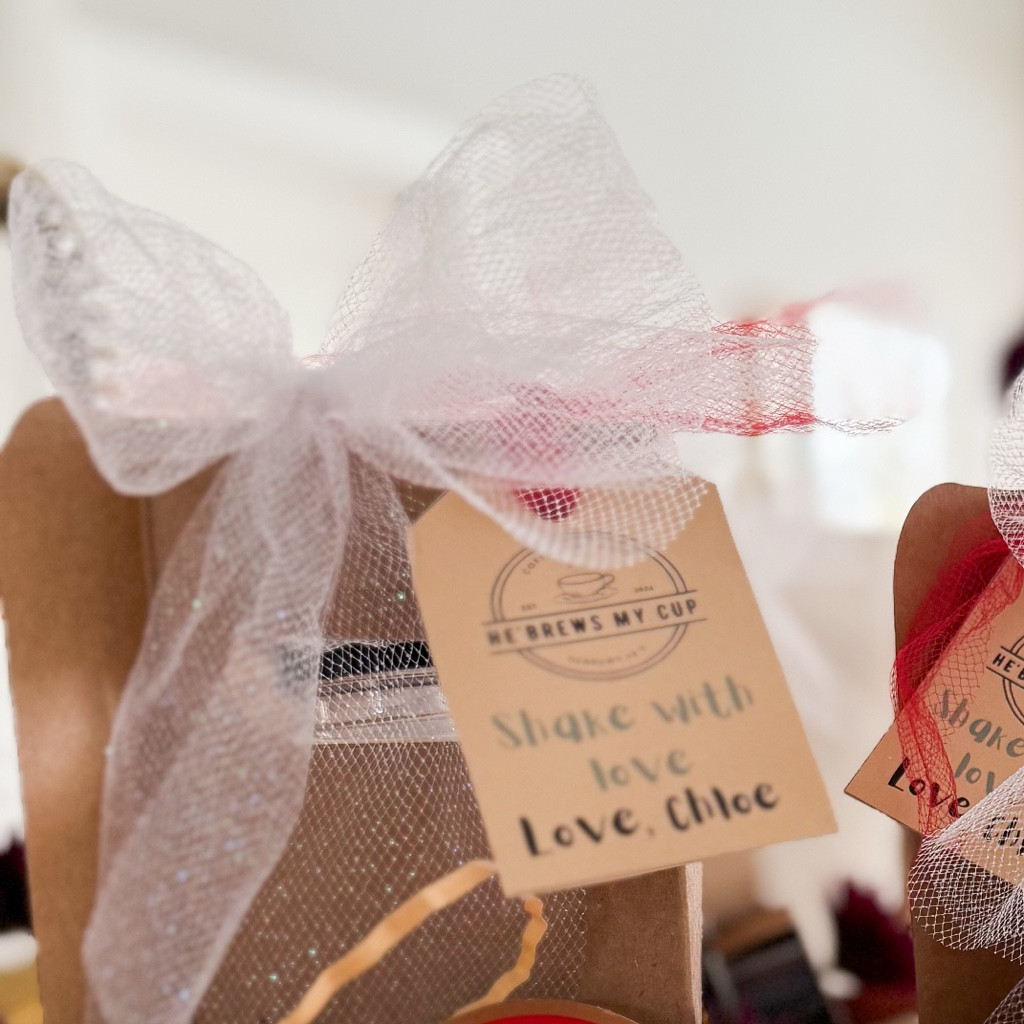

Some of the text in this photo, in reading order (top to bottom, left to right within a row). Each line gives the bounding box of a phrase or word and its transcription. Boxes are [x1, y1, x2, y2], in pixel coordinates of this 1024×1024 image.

[613, 608, 644, 628] MY
[656, 598, 697, 621] CUP
[492, 675, 754, 749] Shake with
[588, 747, 694, 792] love
[666, 782, 779, 832] Chloe
